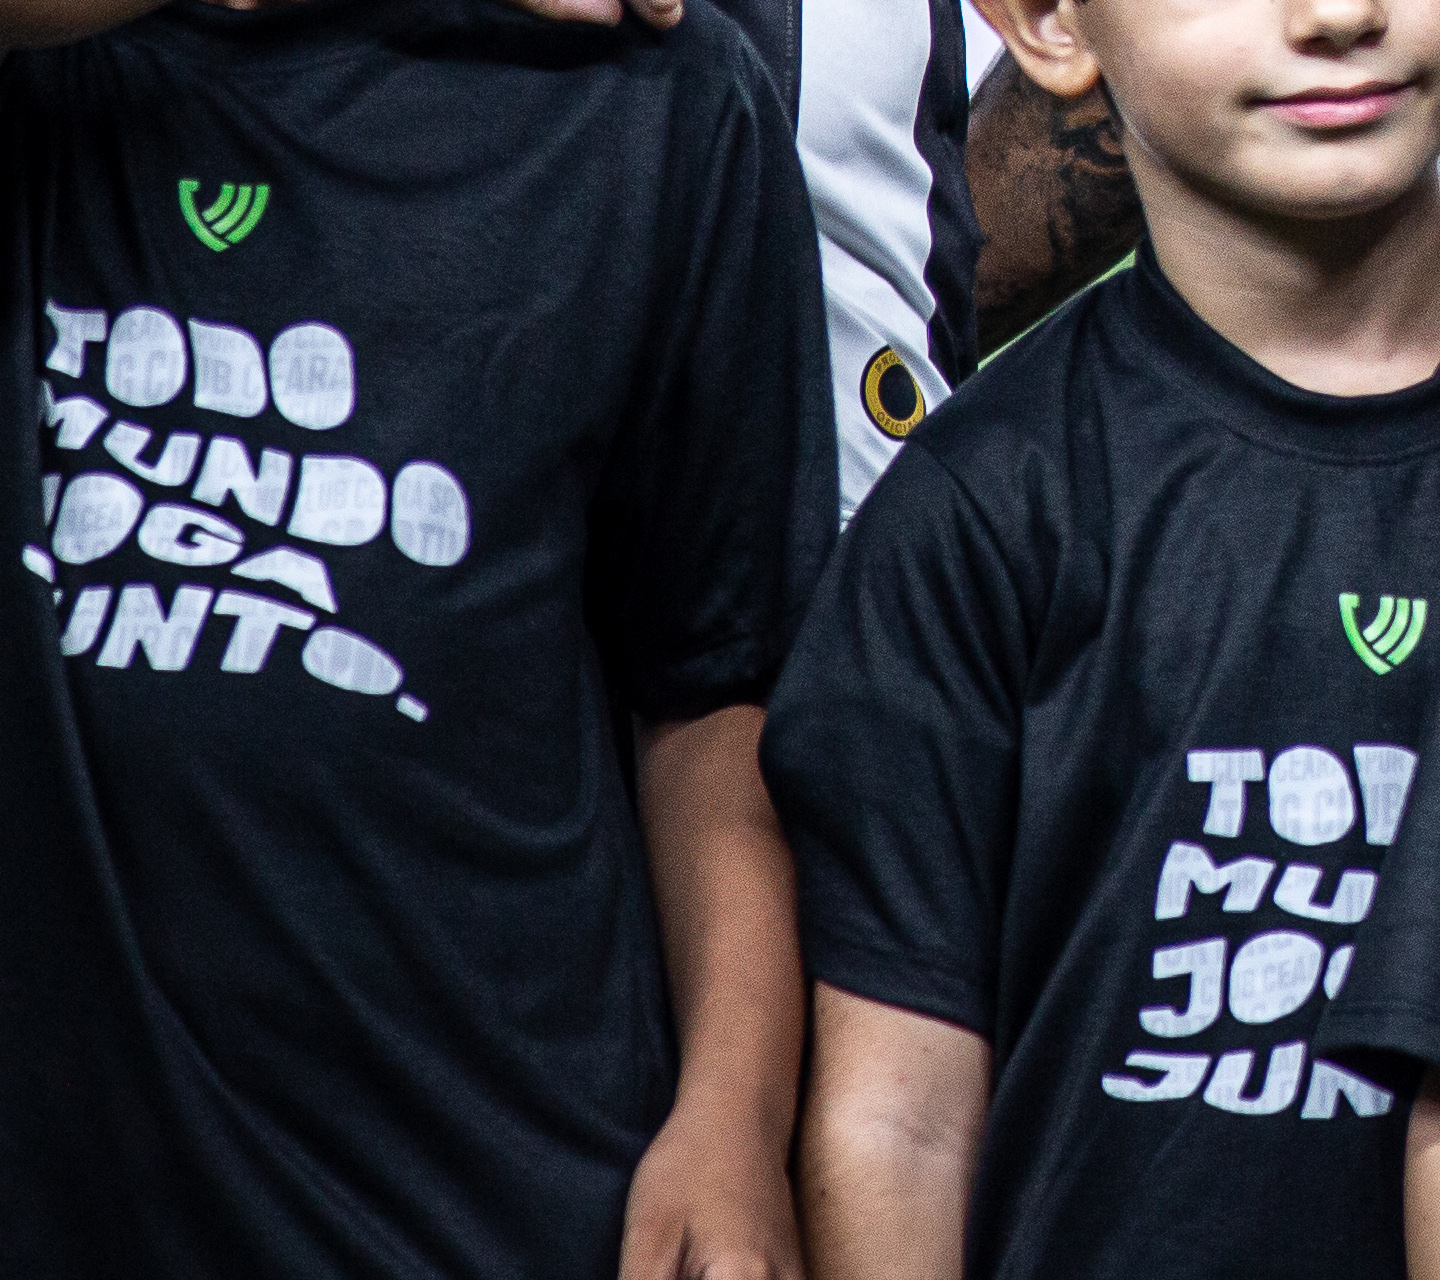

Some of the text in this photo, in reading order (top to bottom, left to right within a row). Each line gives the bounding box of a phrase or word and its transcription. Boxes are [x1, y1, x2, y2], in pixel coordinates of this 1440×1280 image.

[44, 298, 357, 431] TODO
[52, 582, 429, 723] UNTO.
[1185, 743, 1419, 846] TOD
[1137, 928, 1356, 1039] JO
[1100, 1038, 1395, 1120] JUN
